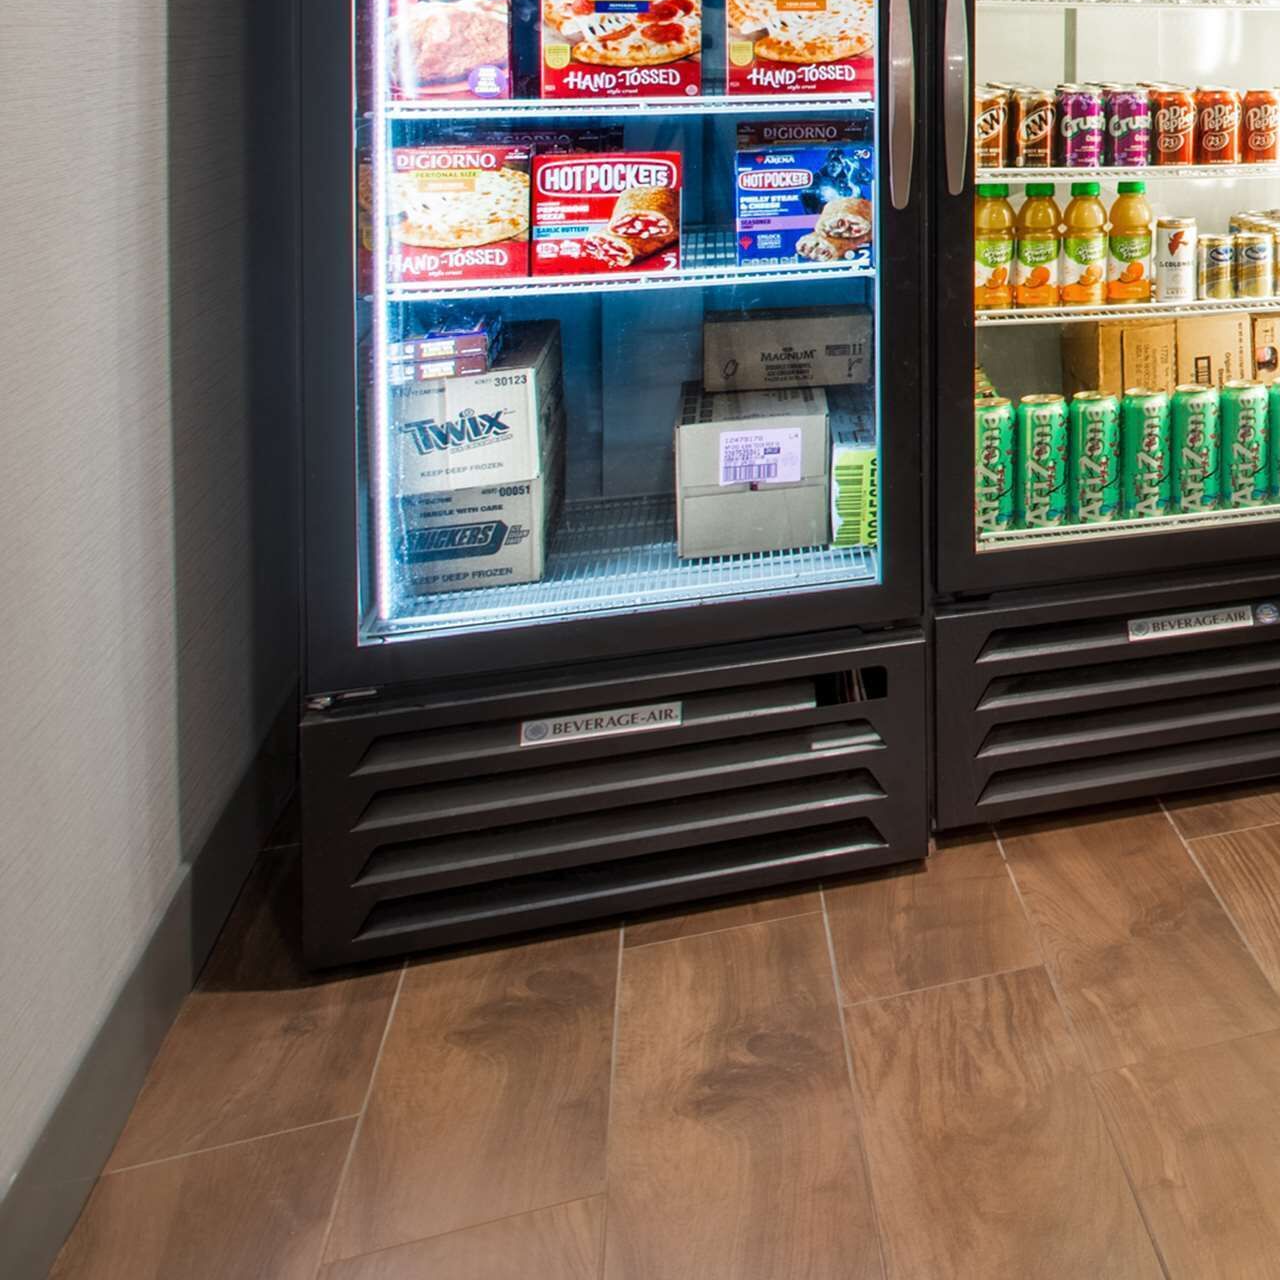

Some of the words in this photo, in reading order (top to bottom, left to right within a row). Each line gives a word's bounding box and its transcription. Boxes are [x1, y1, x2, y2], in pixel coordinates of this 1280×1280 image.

[563, 67, 681, 92] HAND-TOSSED
[747, 64, 856, 88] HAND-TOSSED
[1061, 111, 1106, 138] Crush
[1109, 111, 1153, 138] Crush
[545, 165, 585, 190] HOT
[585, 163, 669, 192] POCKETS
[743, 174, 765, 188] HOT
[766, 172, 809, 186] POCKETS
[663, 257, 677, 270] 2
[760, 349, 816, 362] MAGNUM
[494, 374, 528, 387] 30123
[498, 485, 531, 497] 00051
[407, 523, 493, 552] SNICKERS
[442, 571, 470, 582] DEEP
[471, 567, 513, 580] FROZEN
[1151, 609, 1248, 634] BEVERAGE-AIR
[551, 708, 676, 736] BEVERAGE-AIR
